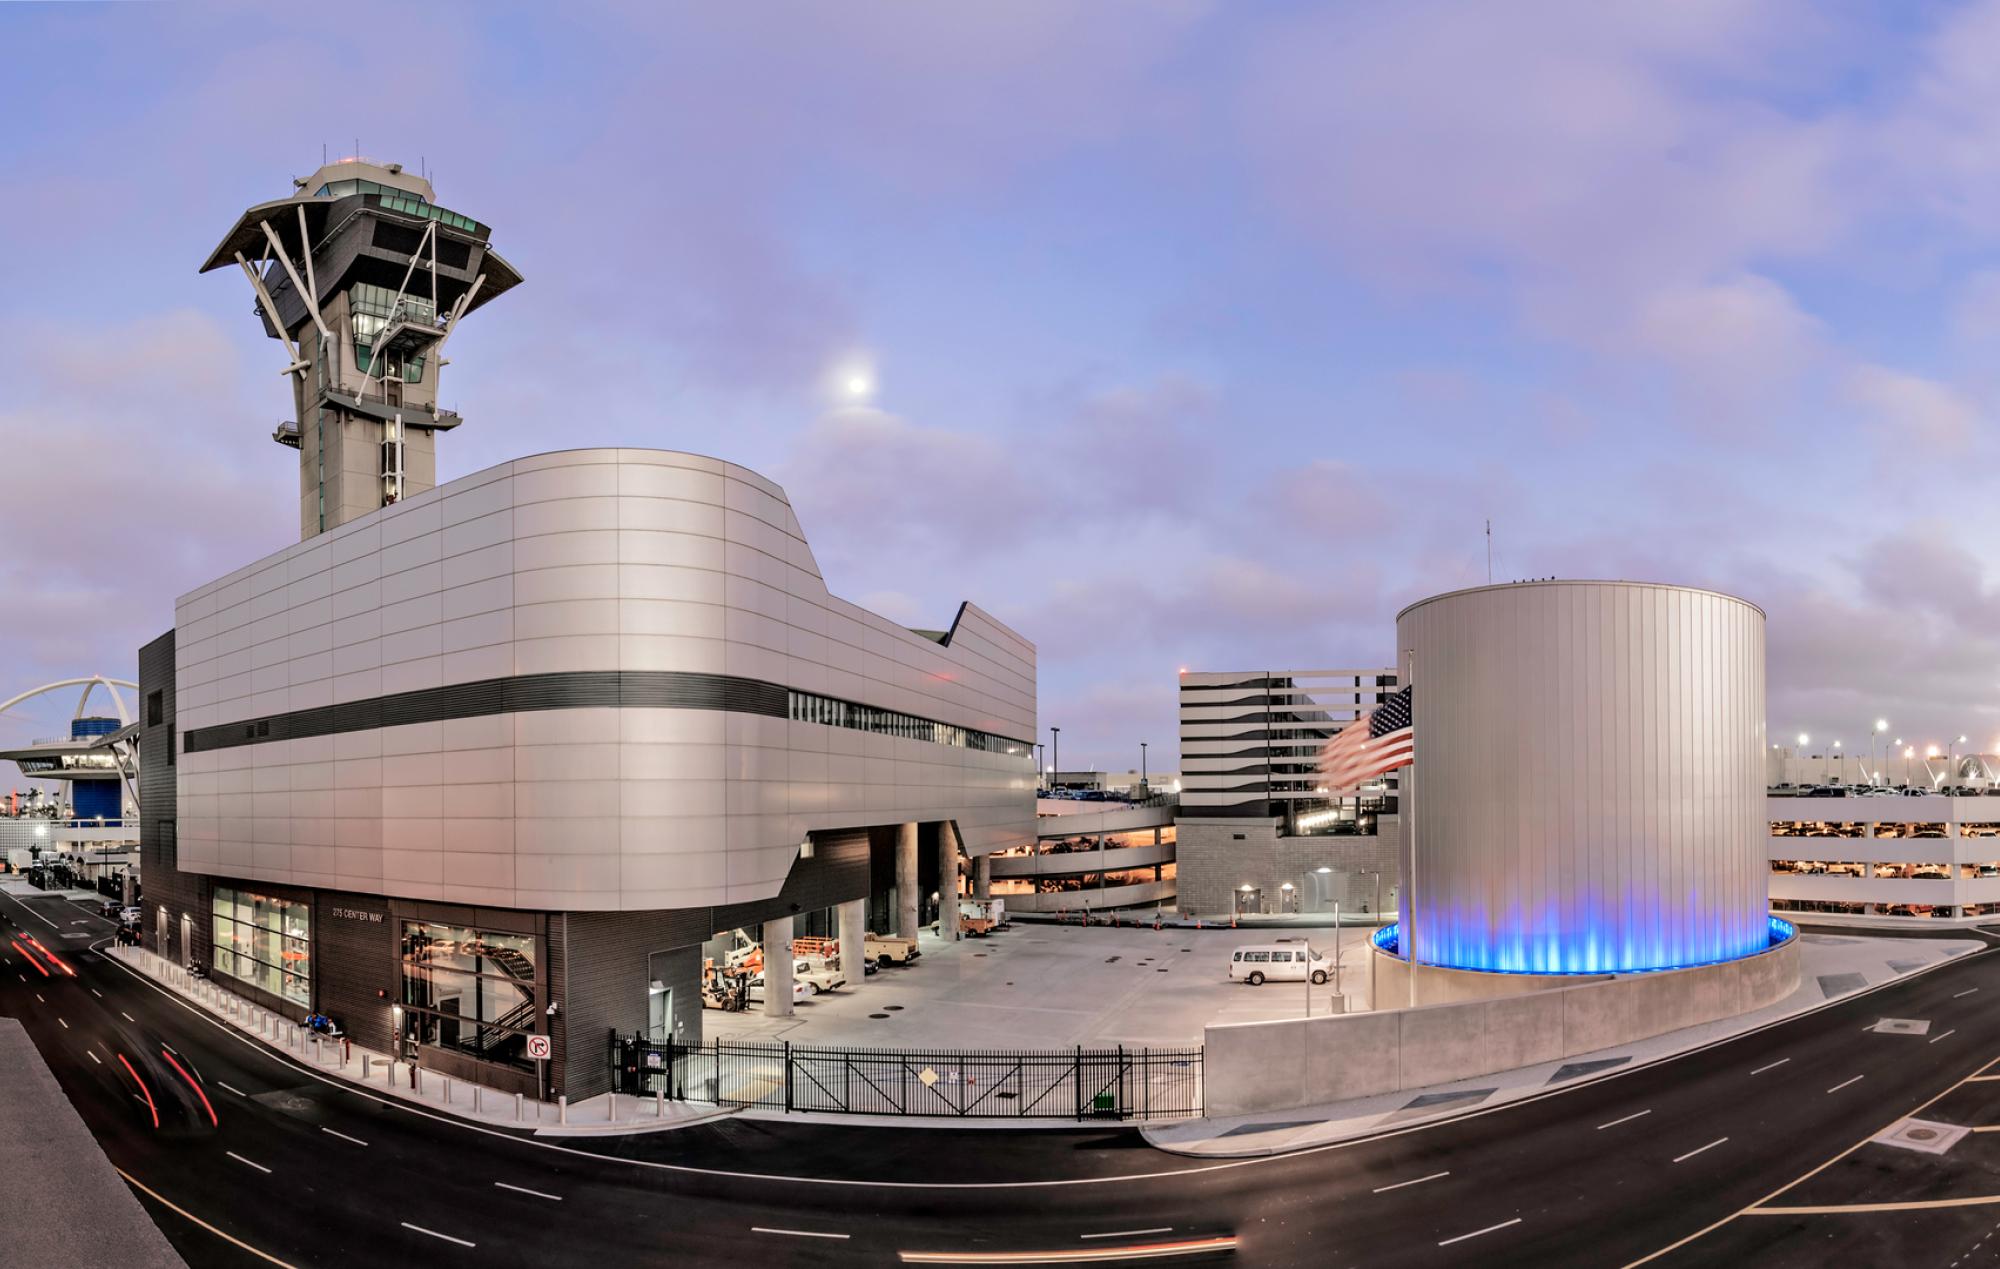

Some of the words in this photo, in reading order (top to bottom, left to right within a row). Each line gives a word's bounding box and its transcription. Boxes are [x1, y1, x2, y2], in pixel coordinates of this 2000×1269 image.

[332, 908, 342, 918] 275
[344, 909, 368, 920] CENTER
[369, 912, 383, 922] WAY
